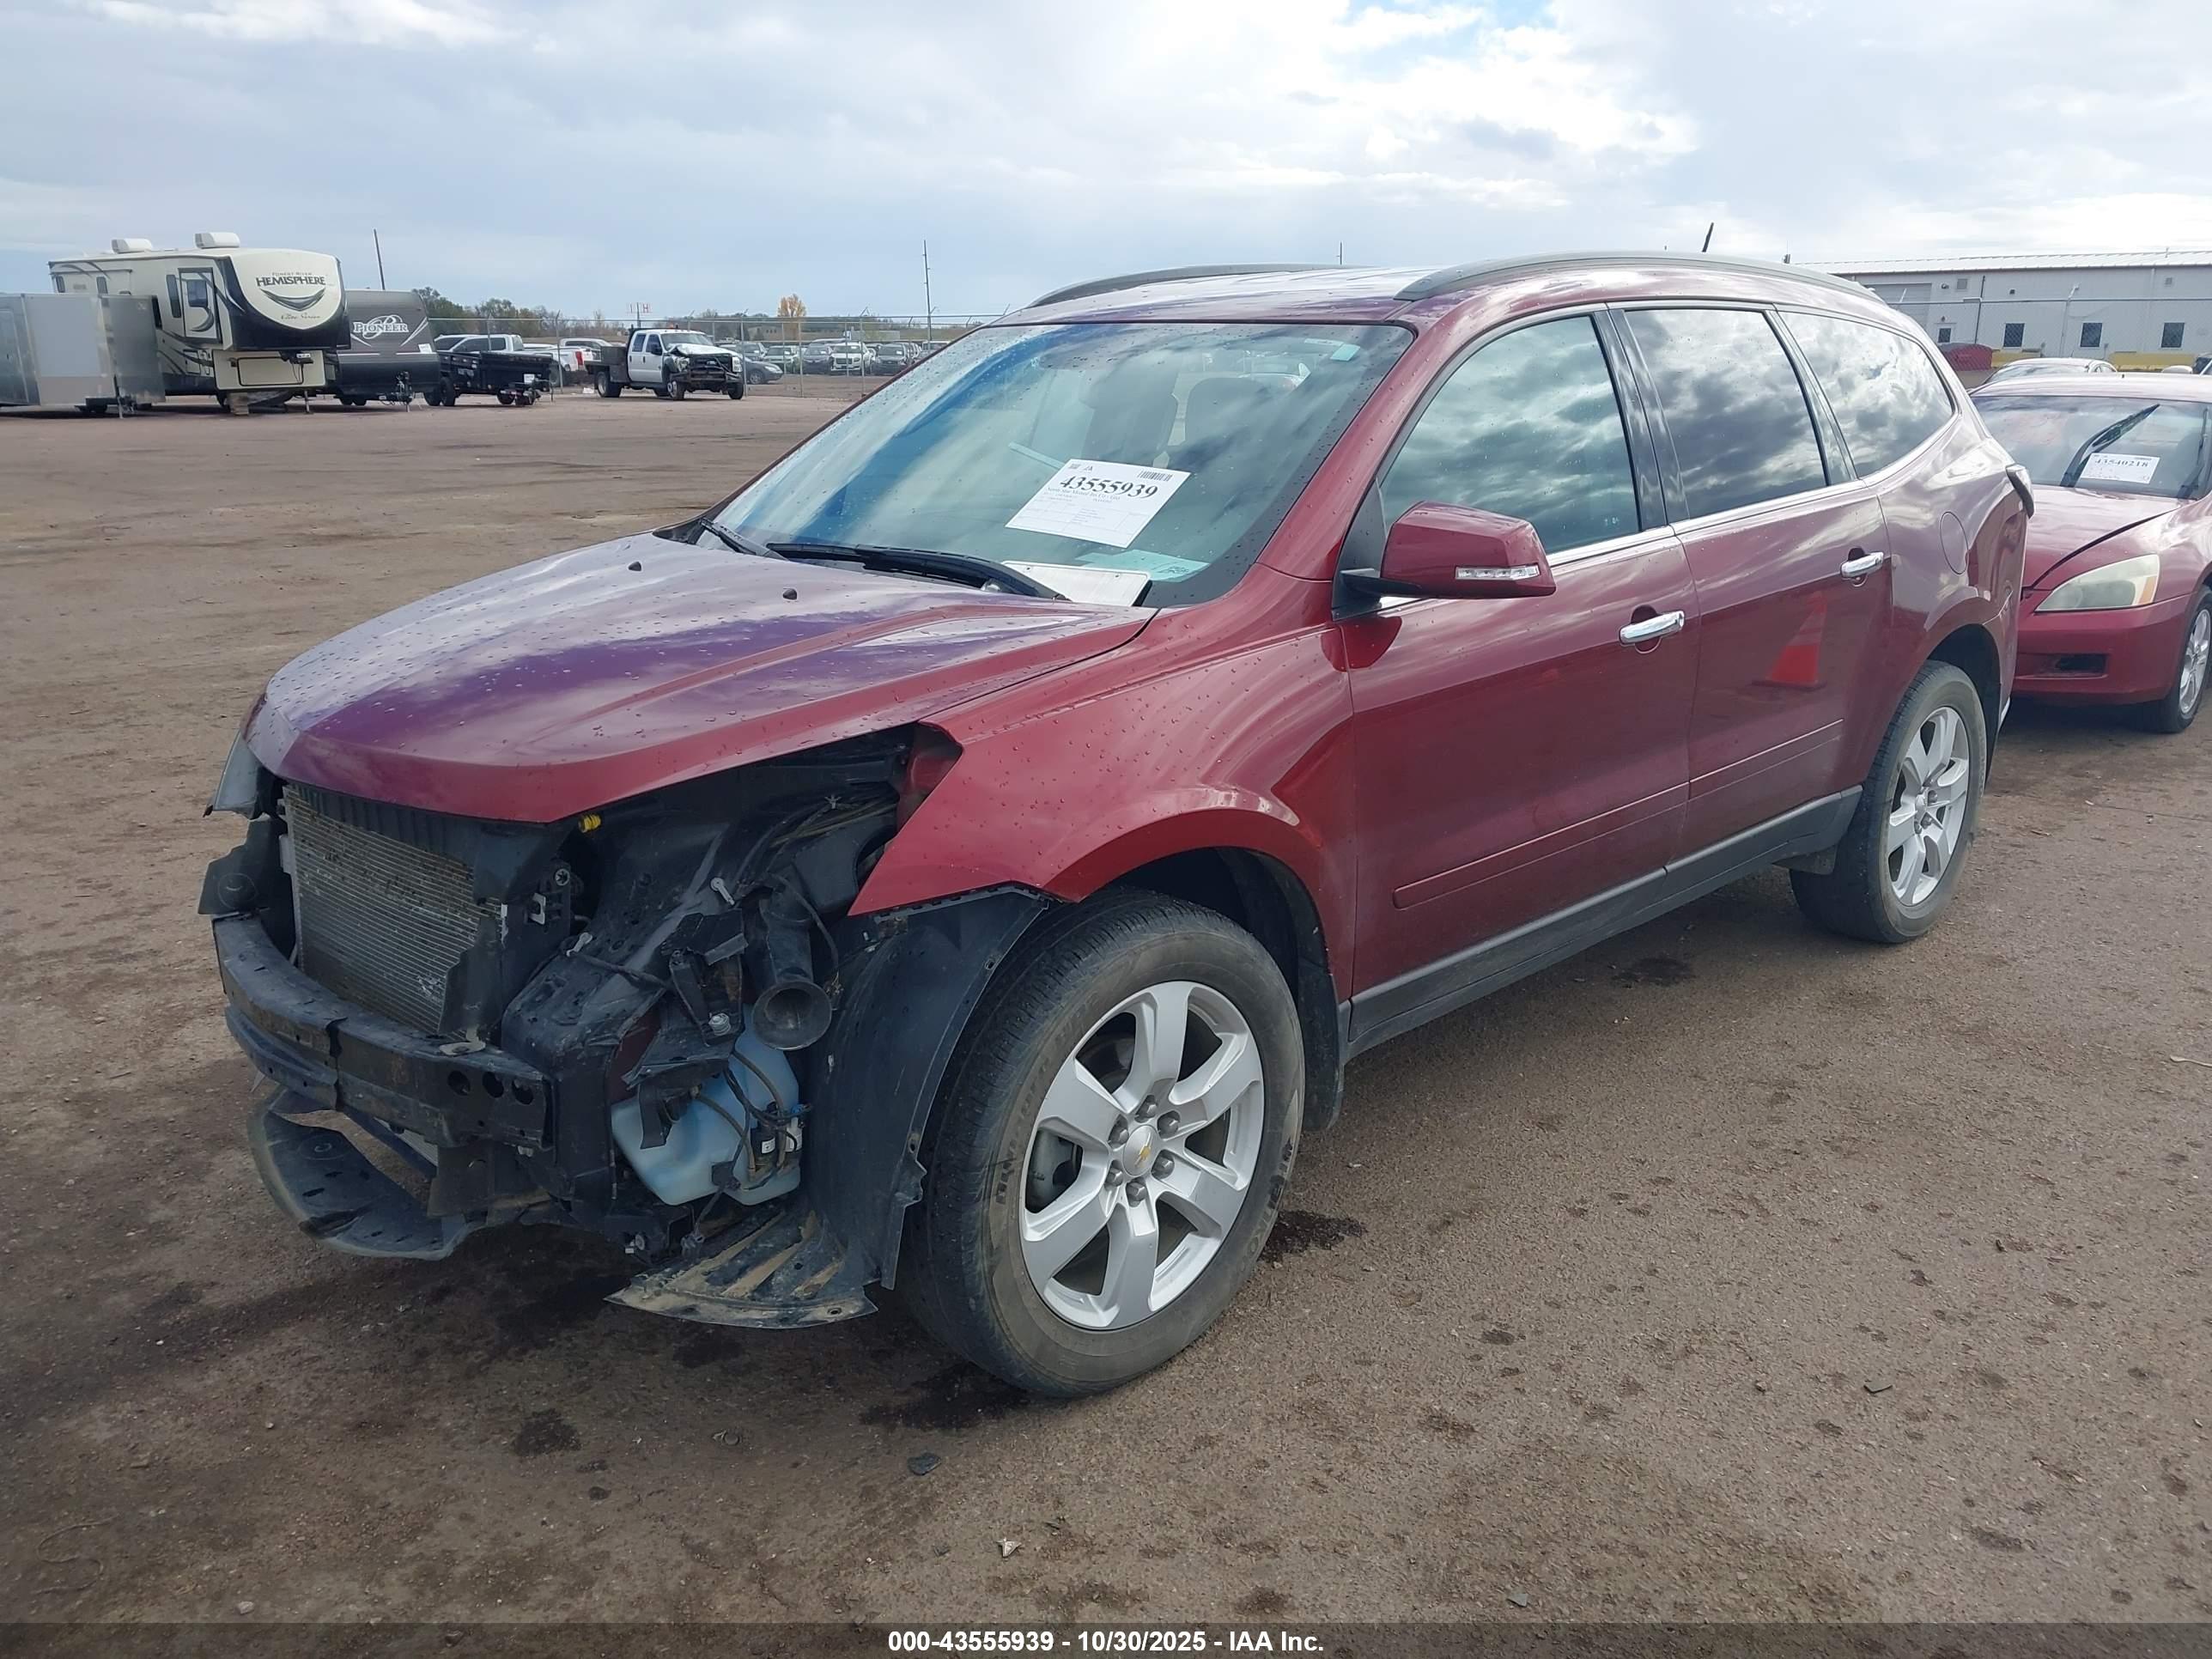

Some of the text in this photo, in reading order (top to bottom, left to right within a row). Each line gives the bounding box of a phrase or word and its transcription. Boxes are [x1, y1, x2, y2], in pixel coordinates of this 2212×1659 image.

[256, 276, 326, 287] HEMISPHERE
[353, 319, 409, 335] PIONEER
[1060, 476, 1158, 499] 43555939
